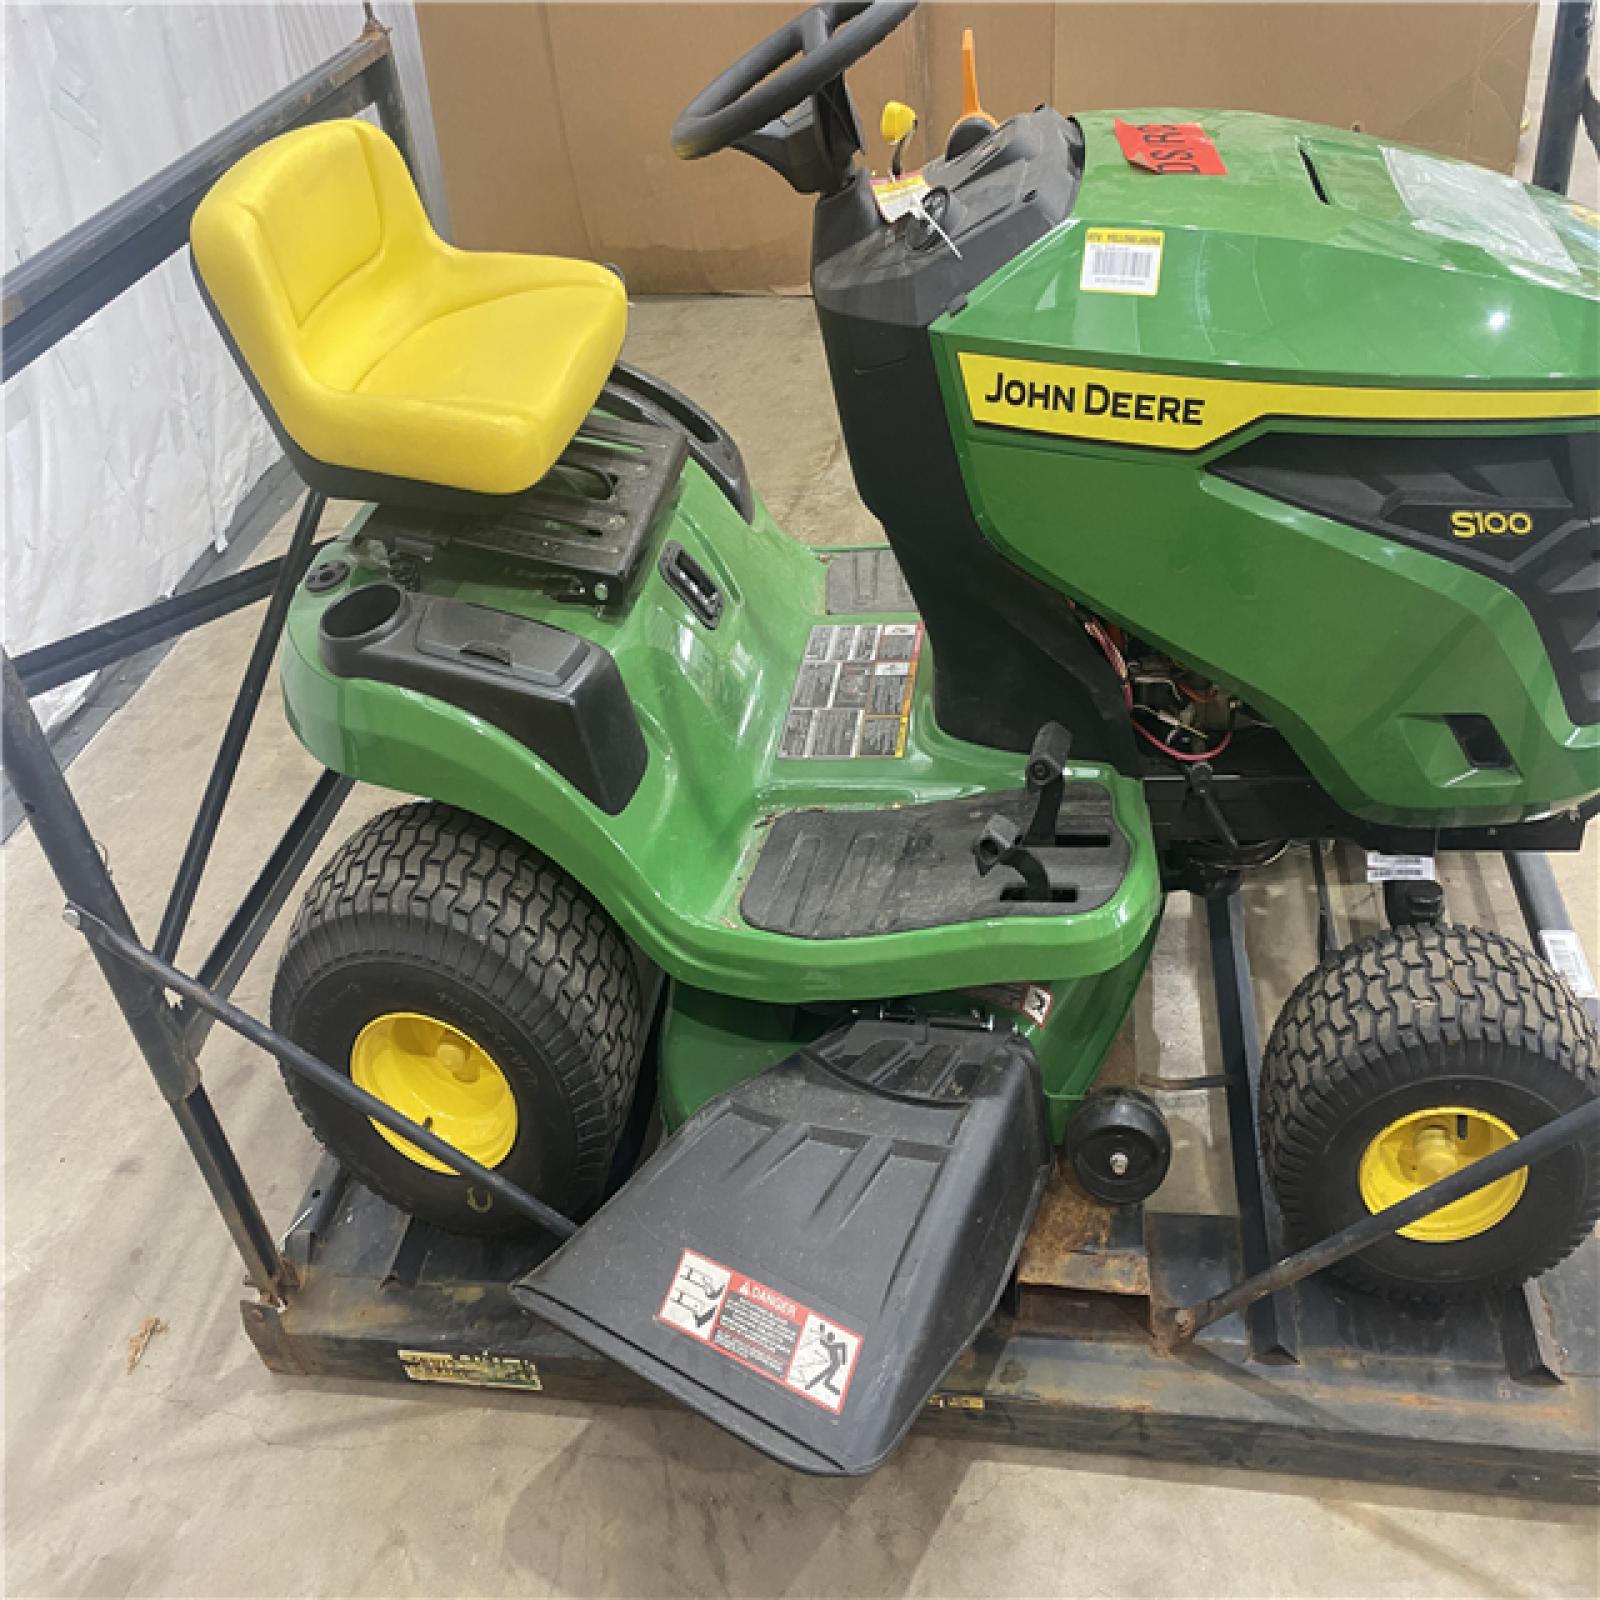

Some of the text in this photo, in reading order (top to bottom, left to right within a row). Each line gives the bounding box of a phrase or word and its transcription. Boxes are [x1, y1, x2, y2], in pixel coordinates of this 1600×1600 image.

[985, 372, 1205, 425] JOHN DEERE
[1451, 511, 1531, 537] S100
